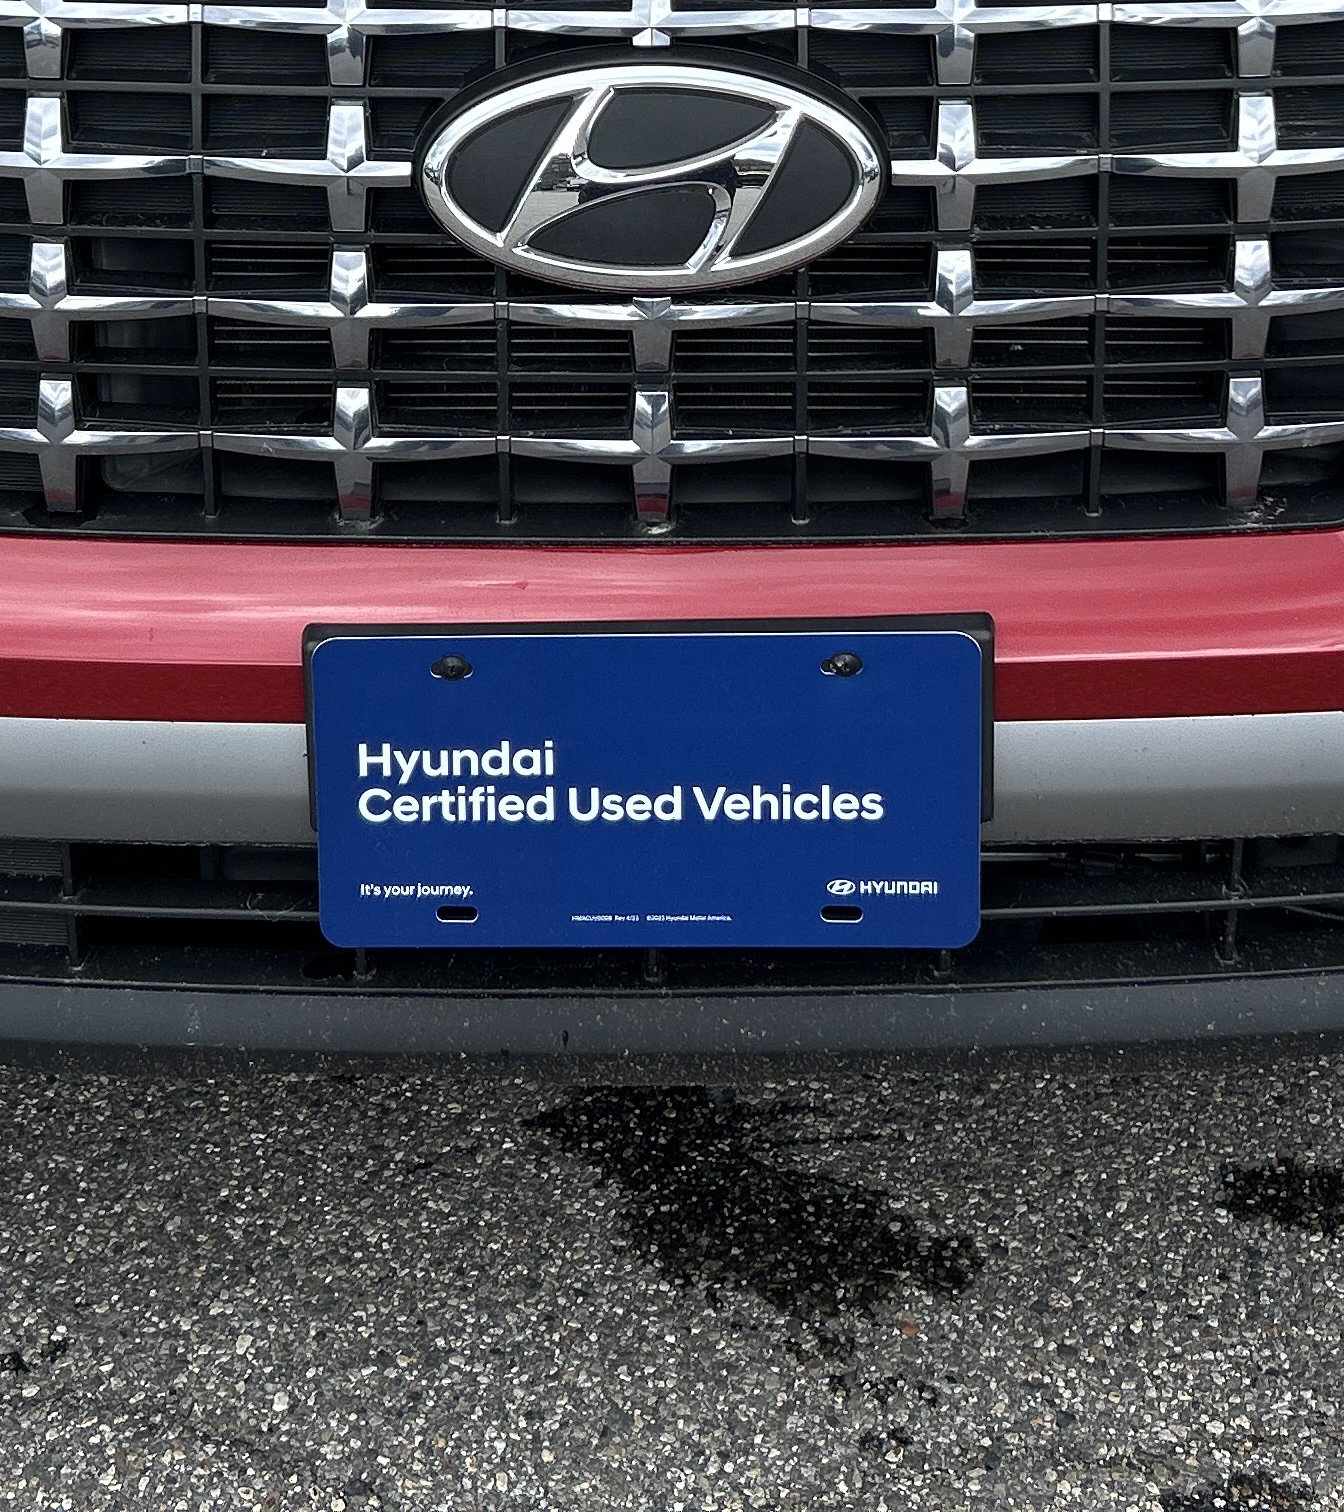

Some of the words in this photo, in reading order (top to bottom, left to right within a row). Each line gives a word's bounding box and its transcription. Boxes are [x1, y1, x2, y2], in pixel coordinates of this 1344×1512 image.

[358, 740, 554, 784] Hyundai
[358, 785, 555, 822] Certified
[568, 785, 682, 822] Used
[692, 783, 884, 821] Vehicles
[360, 883, 382, 896] It's
[383, 885, 416, 899] your
[416, 882, 474, 900] journey.
[859, 880, 938, 895] HYUNDAI
